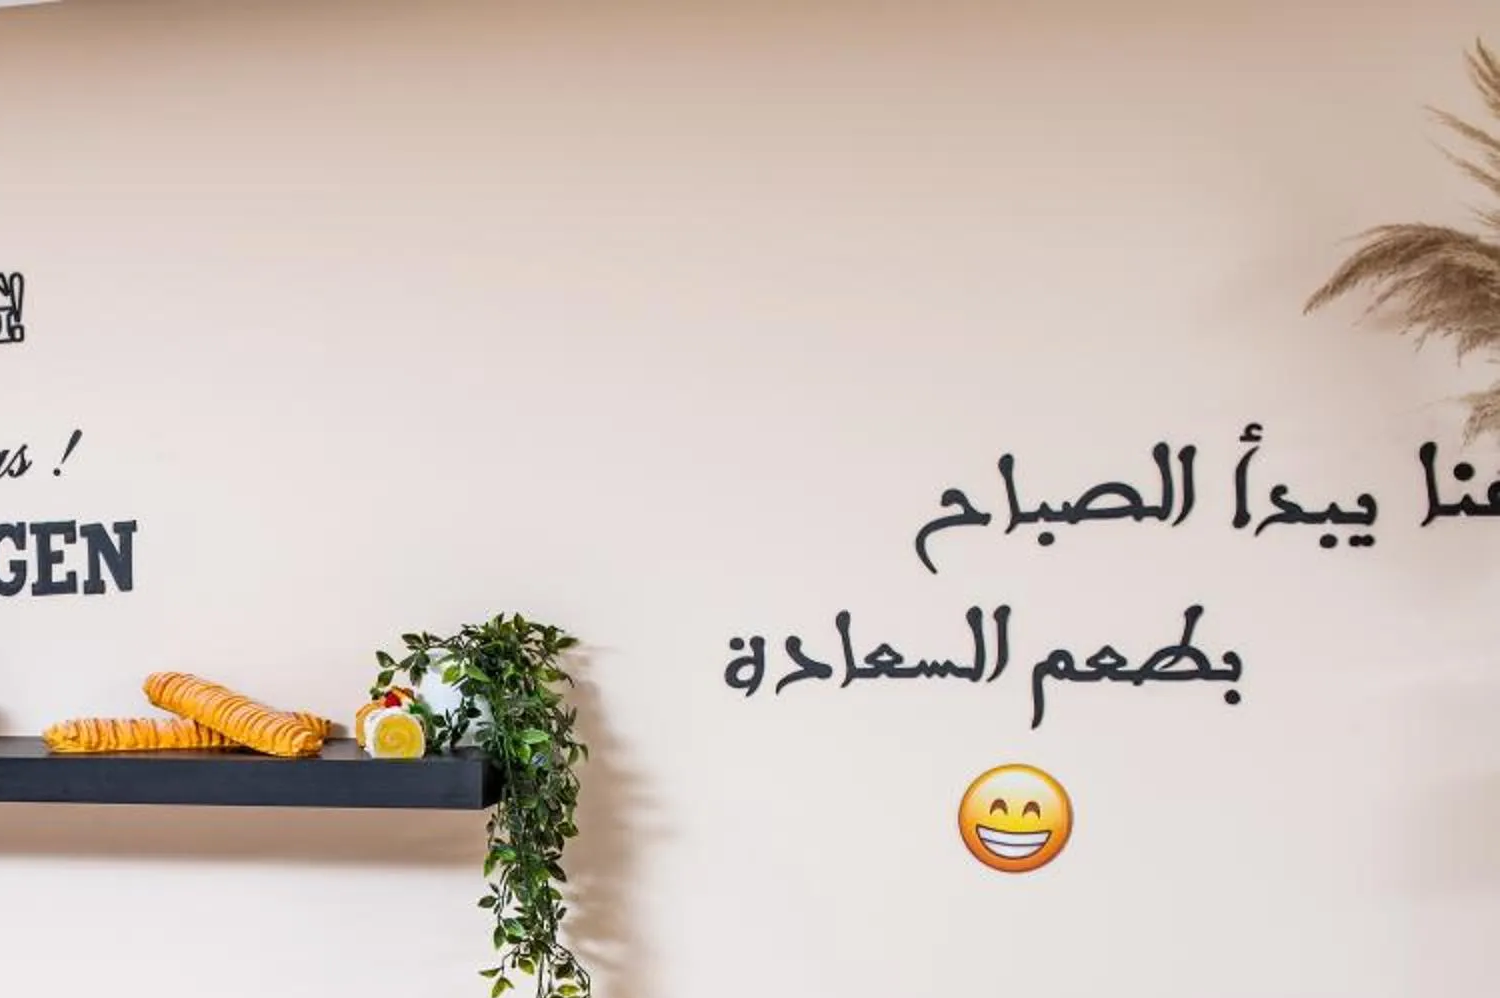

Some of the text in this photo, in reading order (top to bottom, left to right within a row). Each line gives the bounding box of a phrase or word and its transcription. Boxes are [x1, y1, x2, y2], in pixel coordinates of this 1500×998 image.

[914, 441, 1198, 575] الصباح
[1232, 422, 1379, 550] يبدأ
[724, 604, 1243, 730] بطعم السعادة
